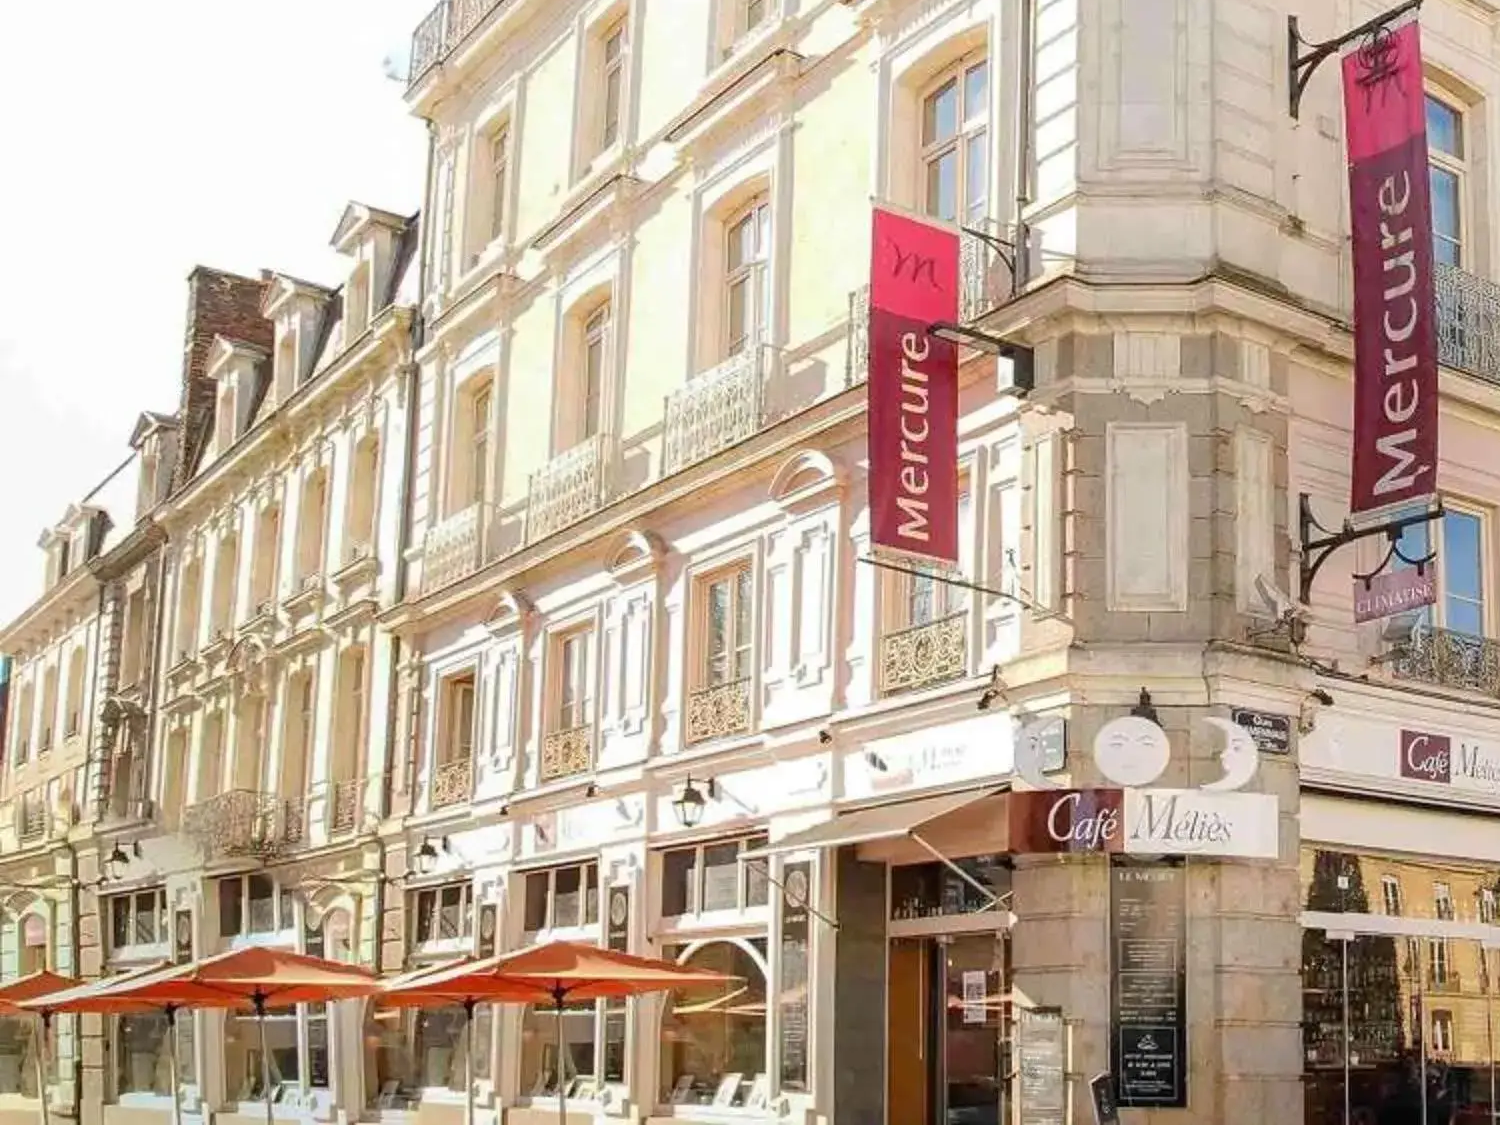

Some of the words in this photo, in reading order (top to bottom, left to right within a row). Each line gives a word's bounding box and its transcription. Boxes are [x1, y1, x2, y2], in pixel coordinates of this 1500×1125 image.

[1372, 170, 1420, 498] Mercure
[895, 331, 931, 542] Mercure
[1047, 792, 1118, 848] Café
[1130, 793, 1233, 844] Méliès
[1407, 736, 1449, 779] Café
